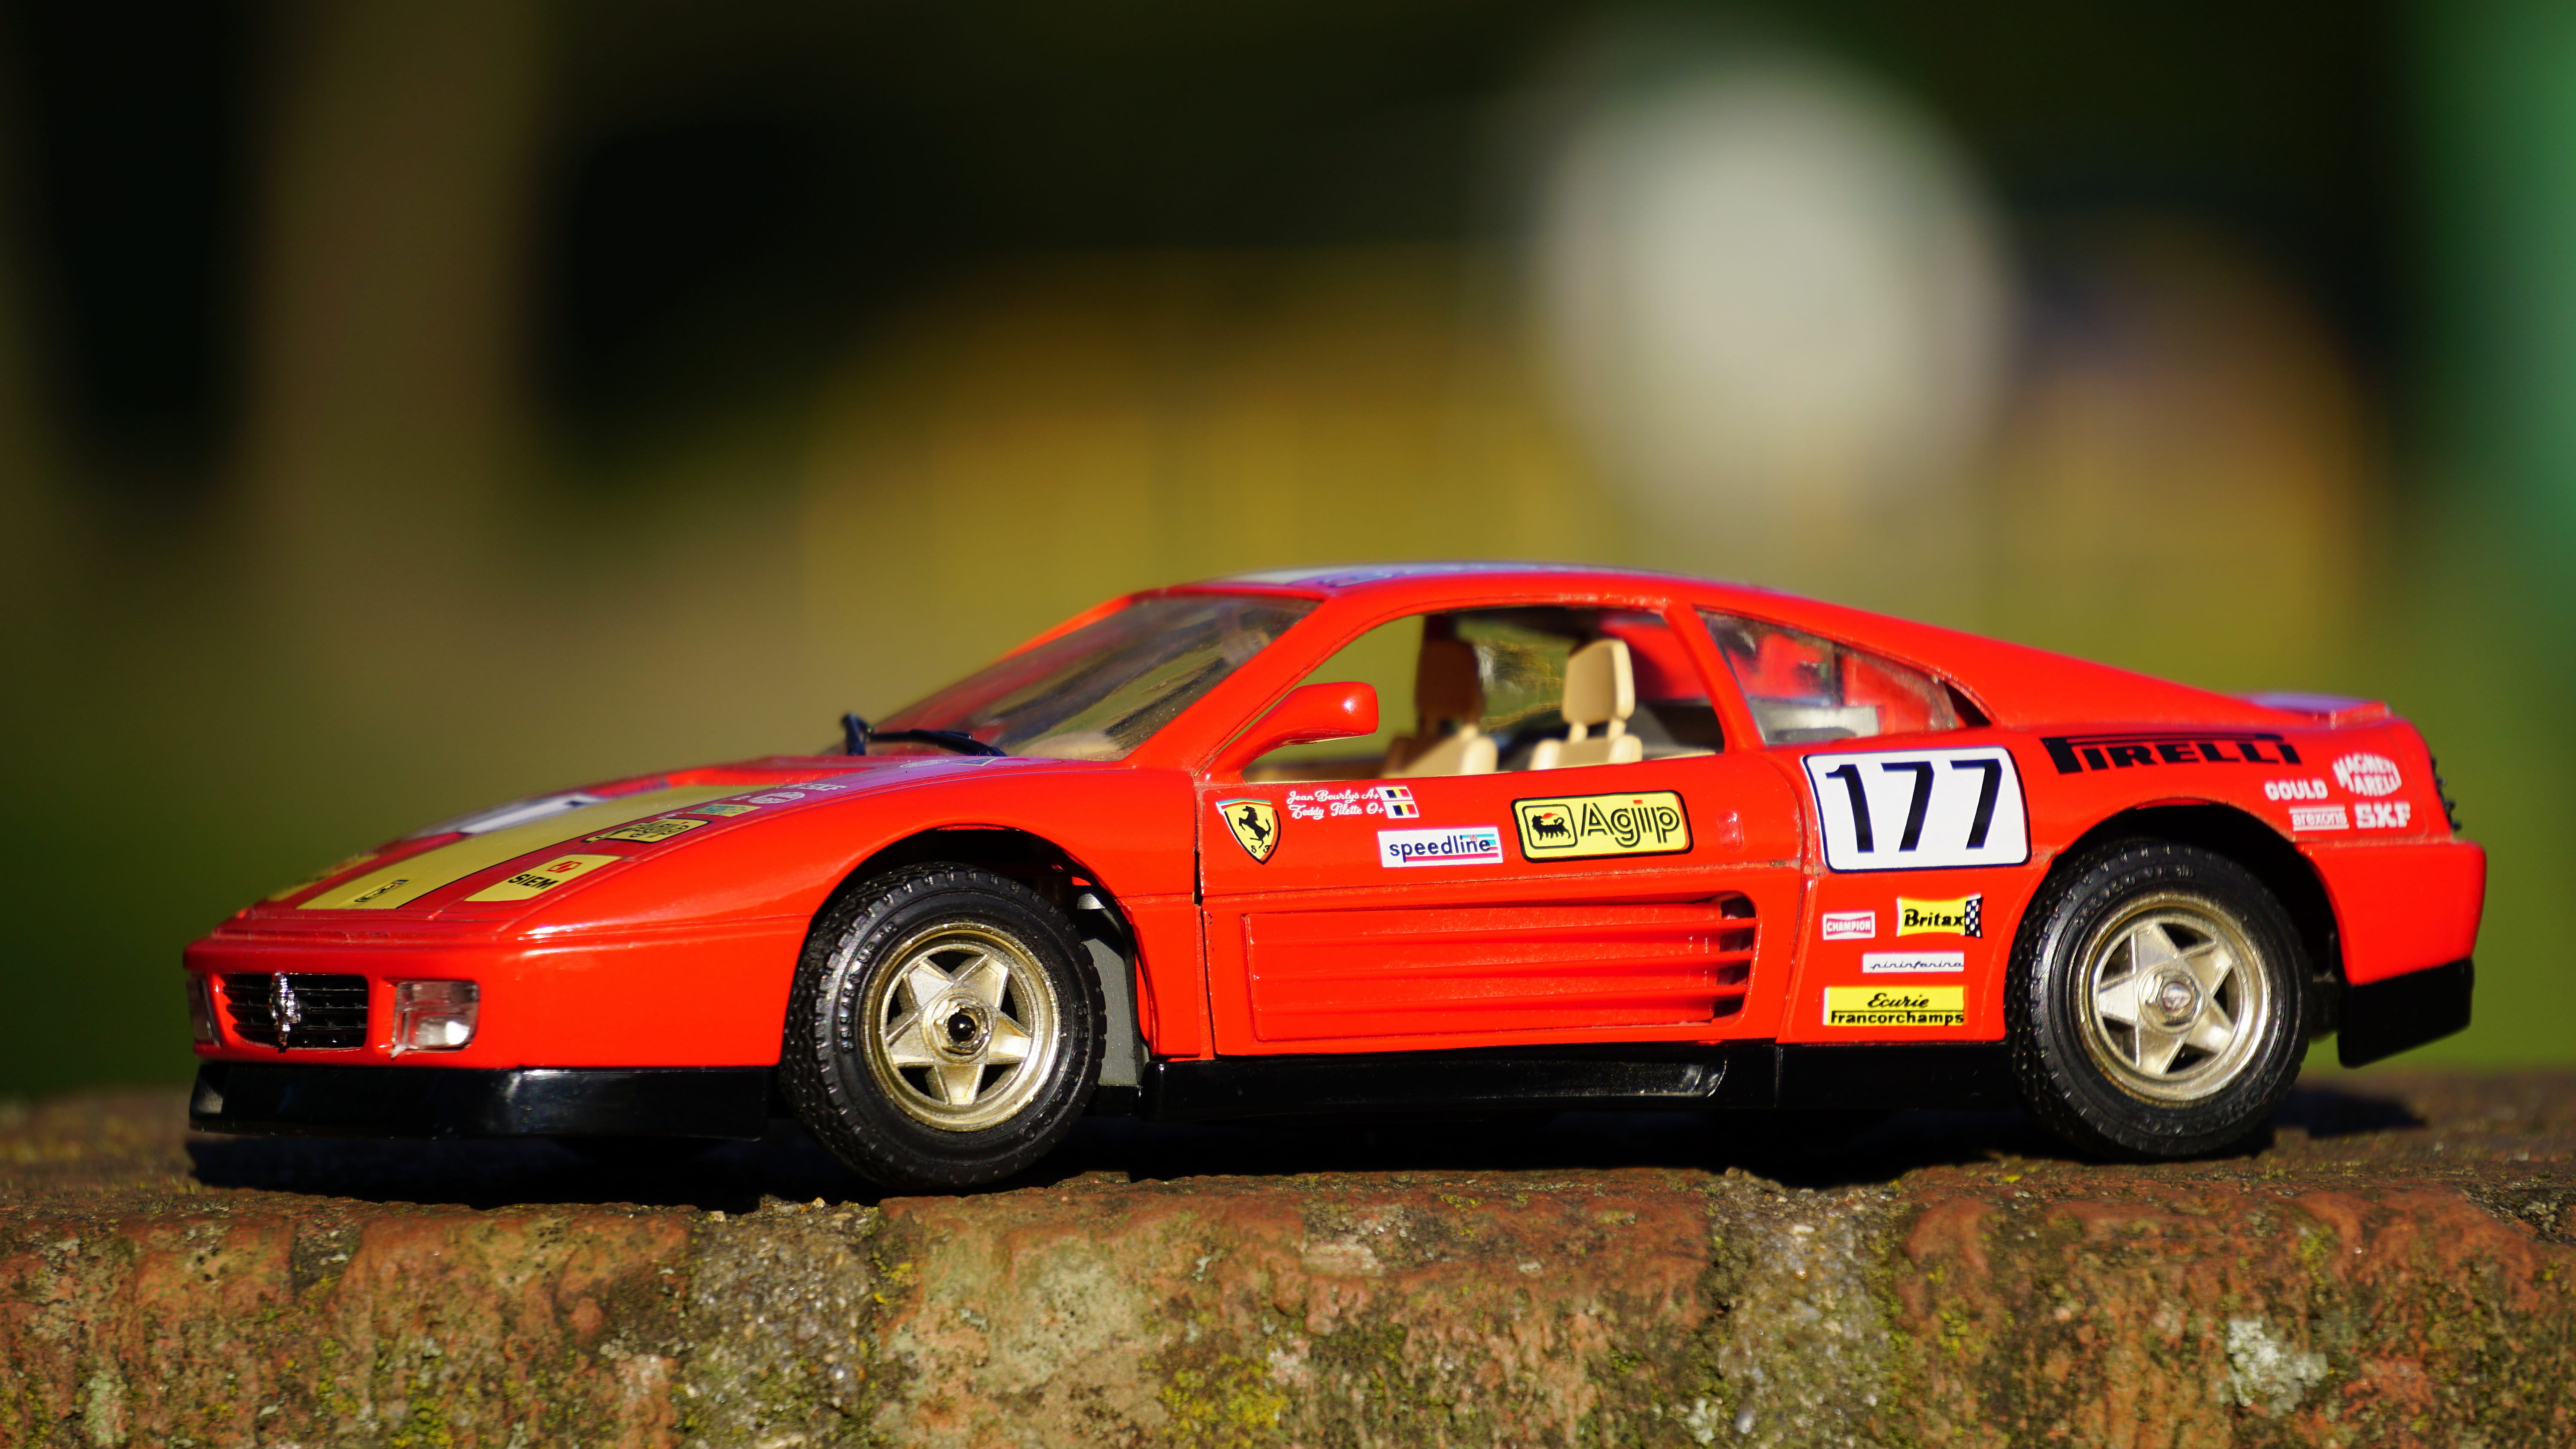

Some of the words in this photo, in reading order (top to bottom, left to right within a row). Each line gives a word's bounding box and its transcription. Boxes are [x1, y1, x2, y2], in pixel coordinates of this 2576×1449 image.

[2041, 733, 2302, 774] PIRELLI
[1286, 791, 1314, 804] Jean
[2265, 779, 2328, 800] GOULD
[1288, 804, 1325, 819] Teddy
[1825, 759, 2003, 853] 177
[2354, 802, 2411, 828] SKF
[1580, 799, 1680, 847] Agip
[1389, 834, 1491, 863] speedline
[507, 874, 559, 890] SIEM
[1826, 920, 1871, 932] CHAMPION
[1904, 909, 1965, 927] Britax
[1868, 993, 1929, 1008] Ecurie
[1831, 1010, 1964, 1026] Francorchamps
